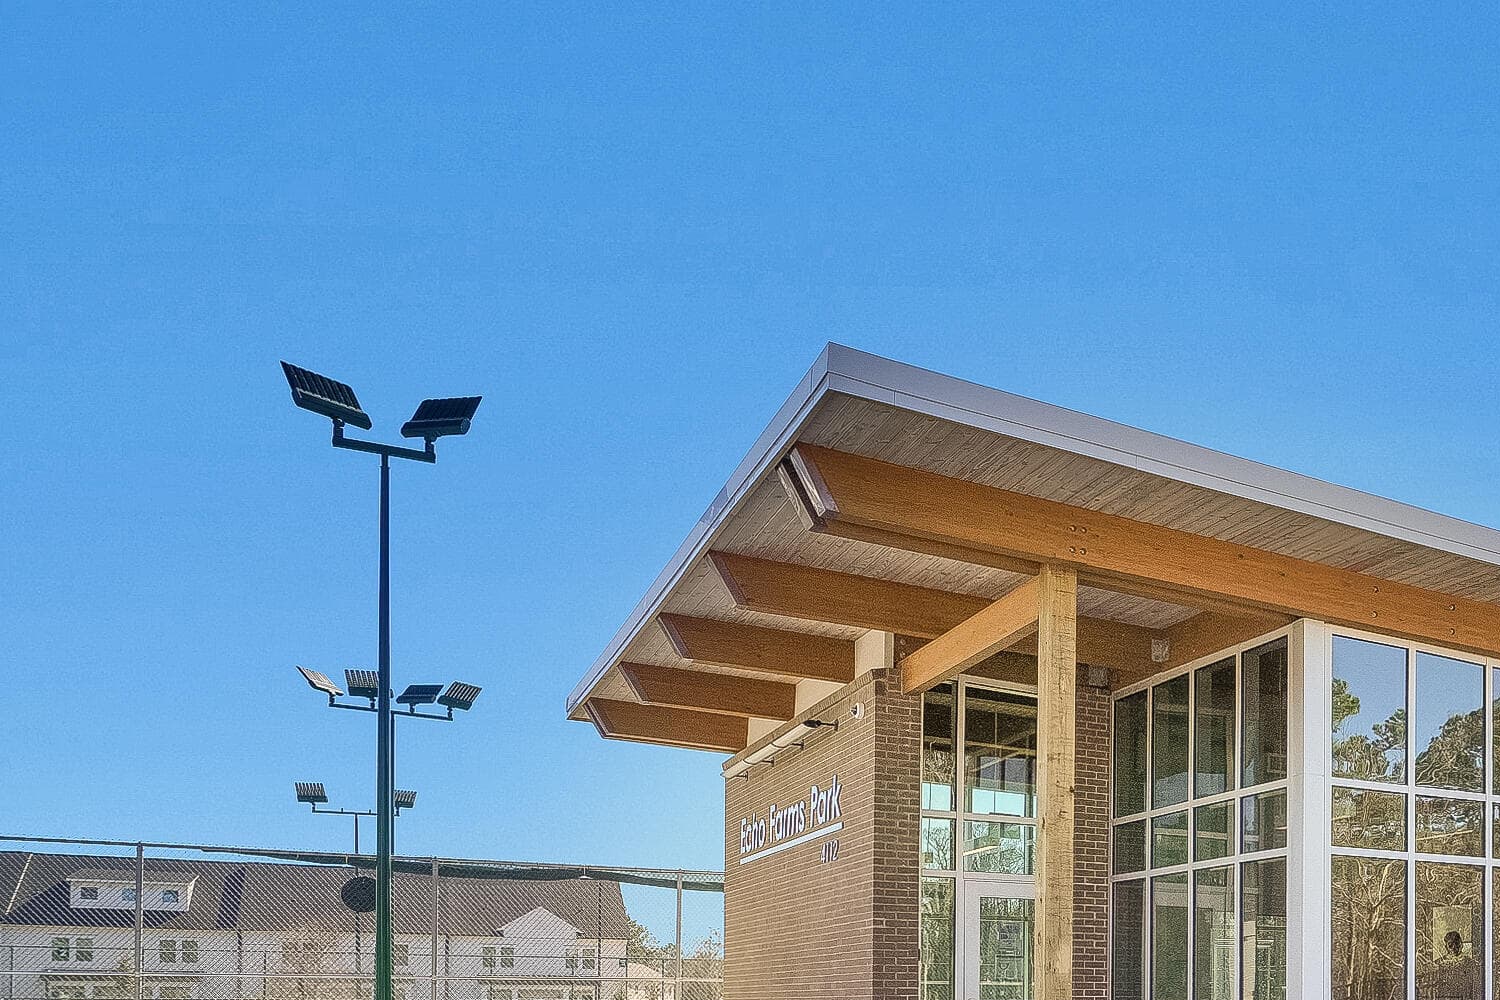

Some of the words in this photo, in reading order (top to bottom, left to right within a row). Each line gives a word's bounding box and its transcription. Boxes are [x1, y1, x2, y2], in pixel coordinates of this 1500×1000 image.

[741, 812, 766, 853] Echo
[769, 800, 806, 842] Farms
[809, 774, 842, 828] Park
